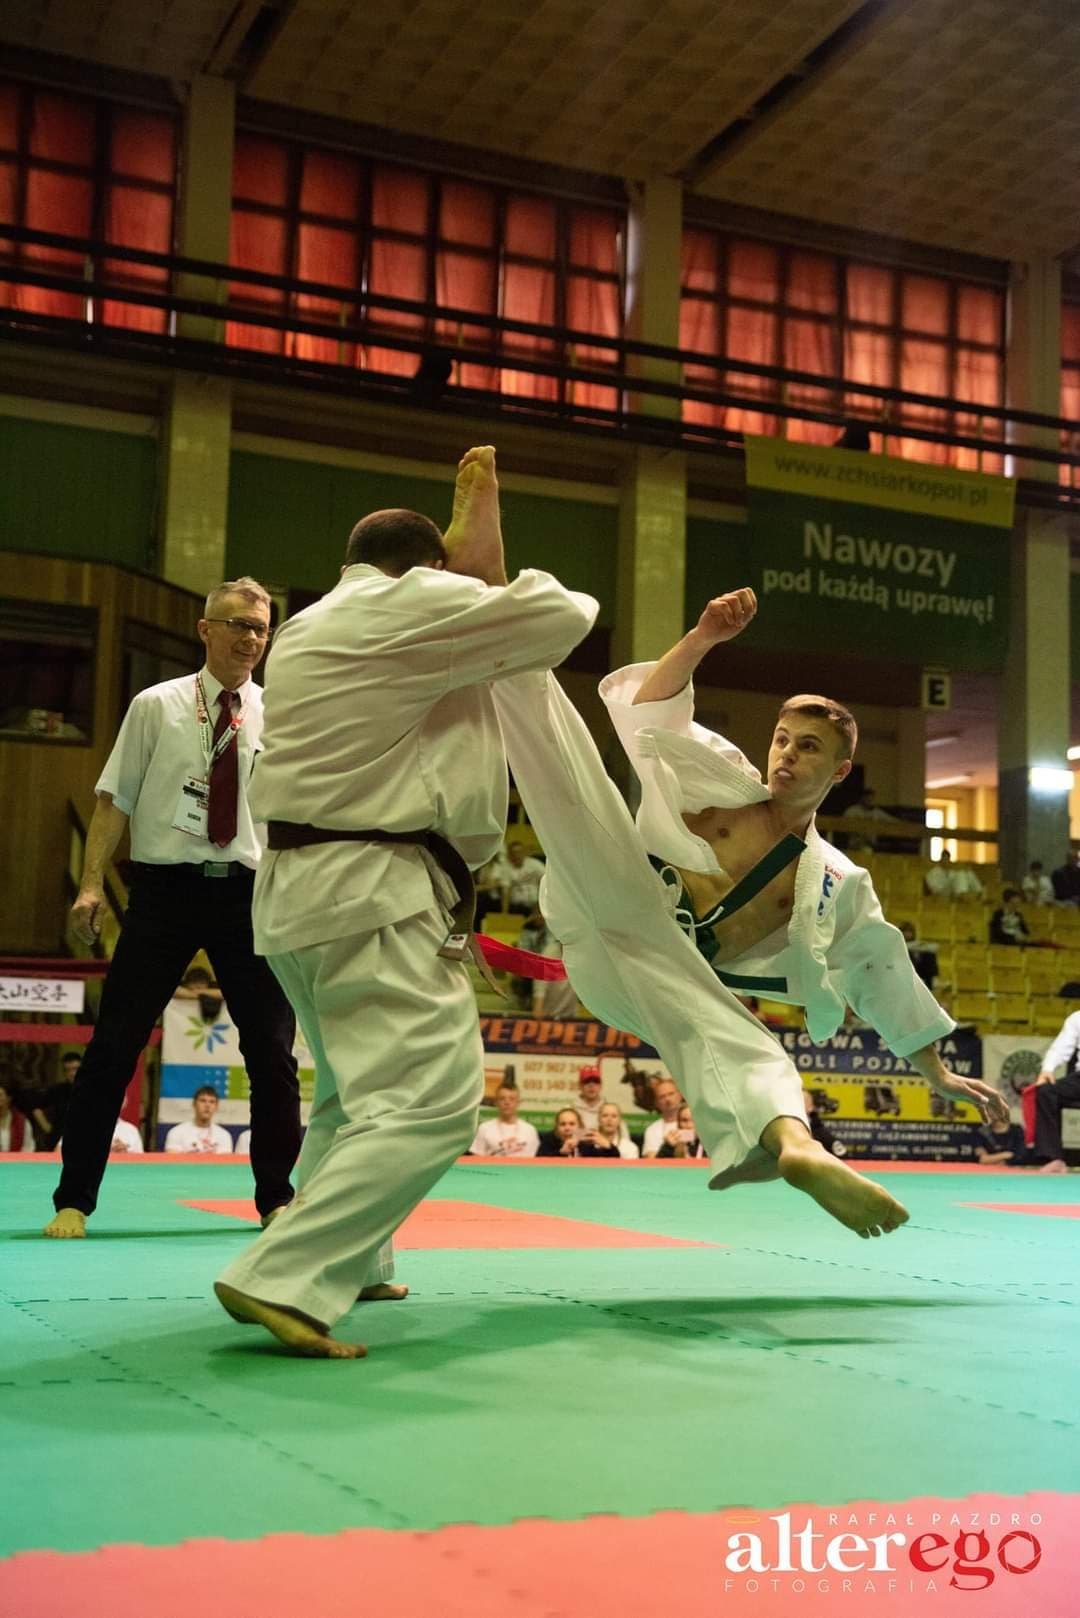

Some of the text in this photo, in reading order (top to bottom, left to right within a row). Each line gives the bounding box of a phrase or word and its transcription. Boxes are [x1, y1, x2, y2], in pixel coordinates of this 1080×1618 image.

[803, 520, 957, 588] Nawozy
[763, 568, 995, 625] pod każdą uprawę!
[927, 679, 946, 705] E
[852, 1055, 973, 1075] POJAÓW
